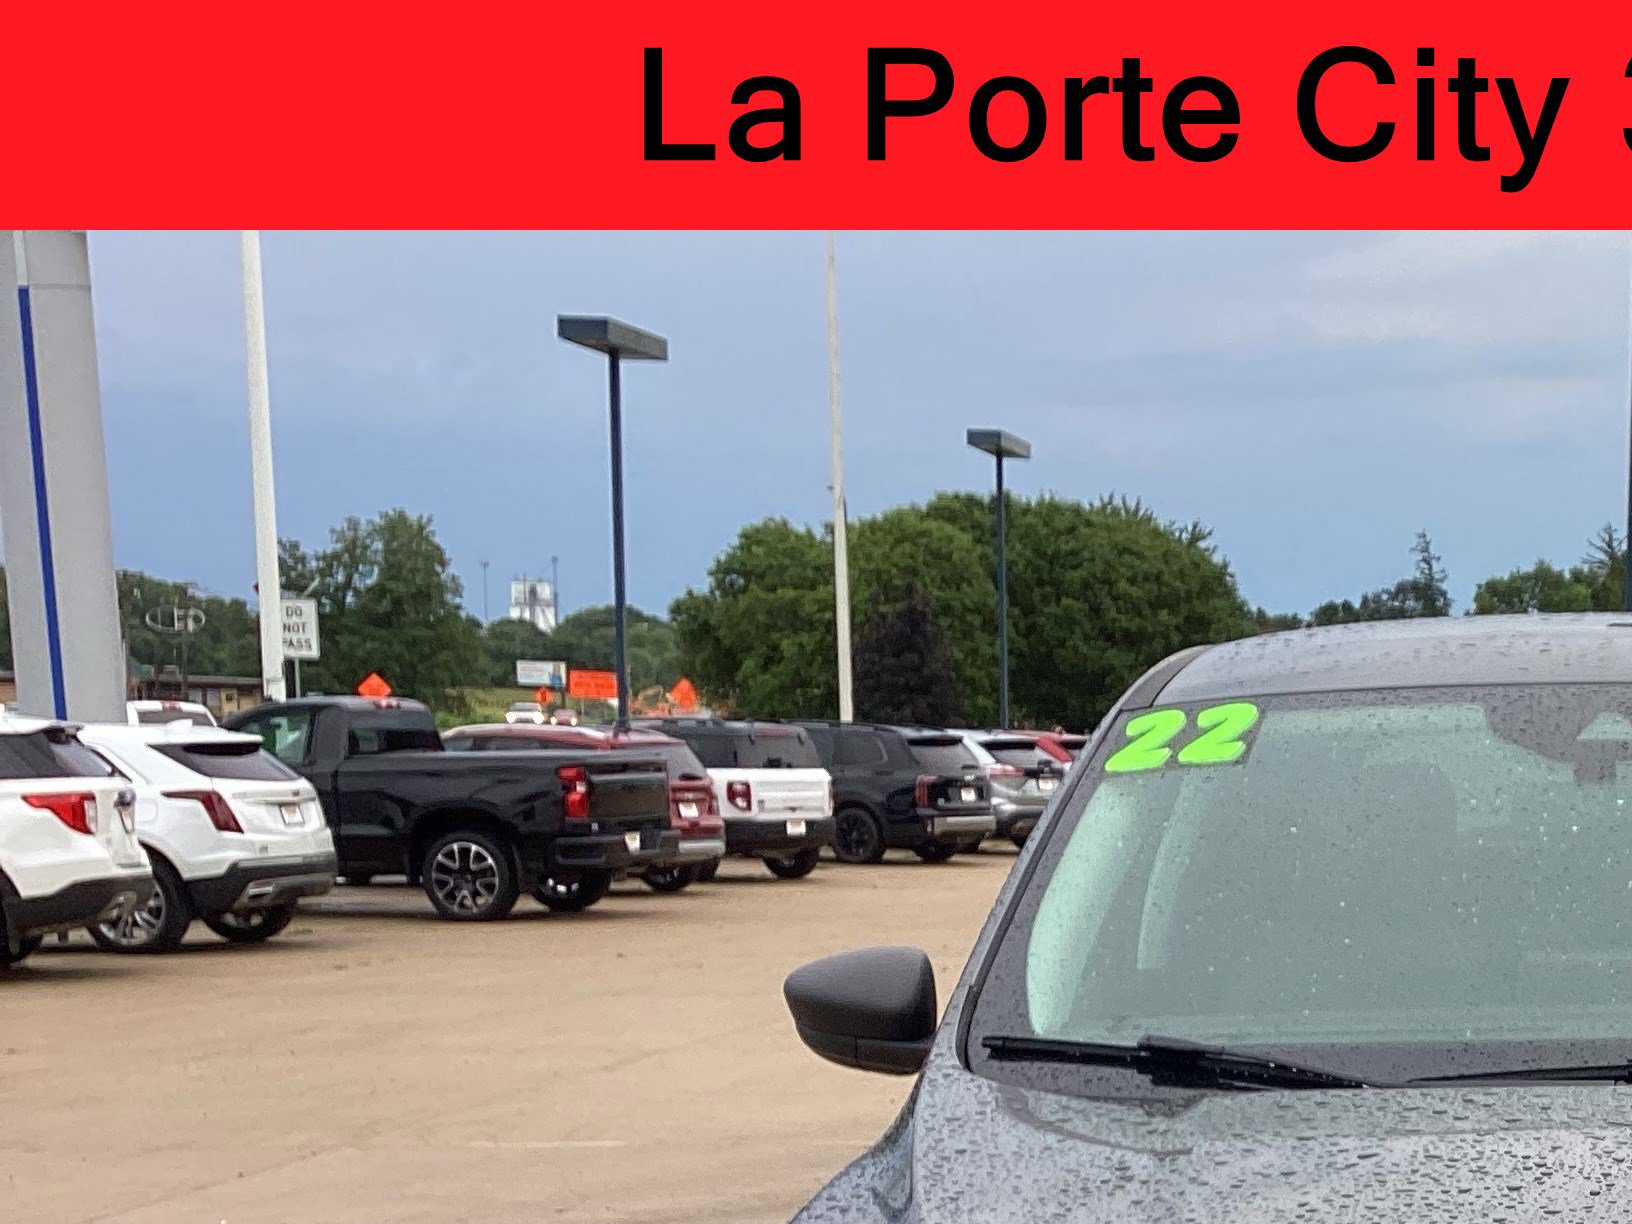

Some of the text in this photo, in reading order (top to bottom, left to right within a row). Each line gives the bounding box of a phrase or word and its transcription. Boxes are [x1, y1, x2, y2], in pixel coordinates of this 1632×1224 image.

[286, 605, 302, 618] DO
[283, 621, 306, 634] NOT
[1104, 702, 1259, 773] 22
